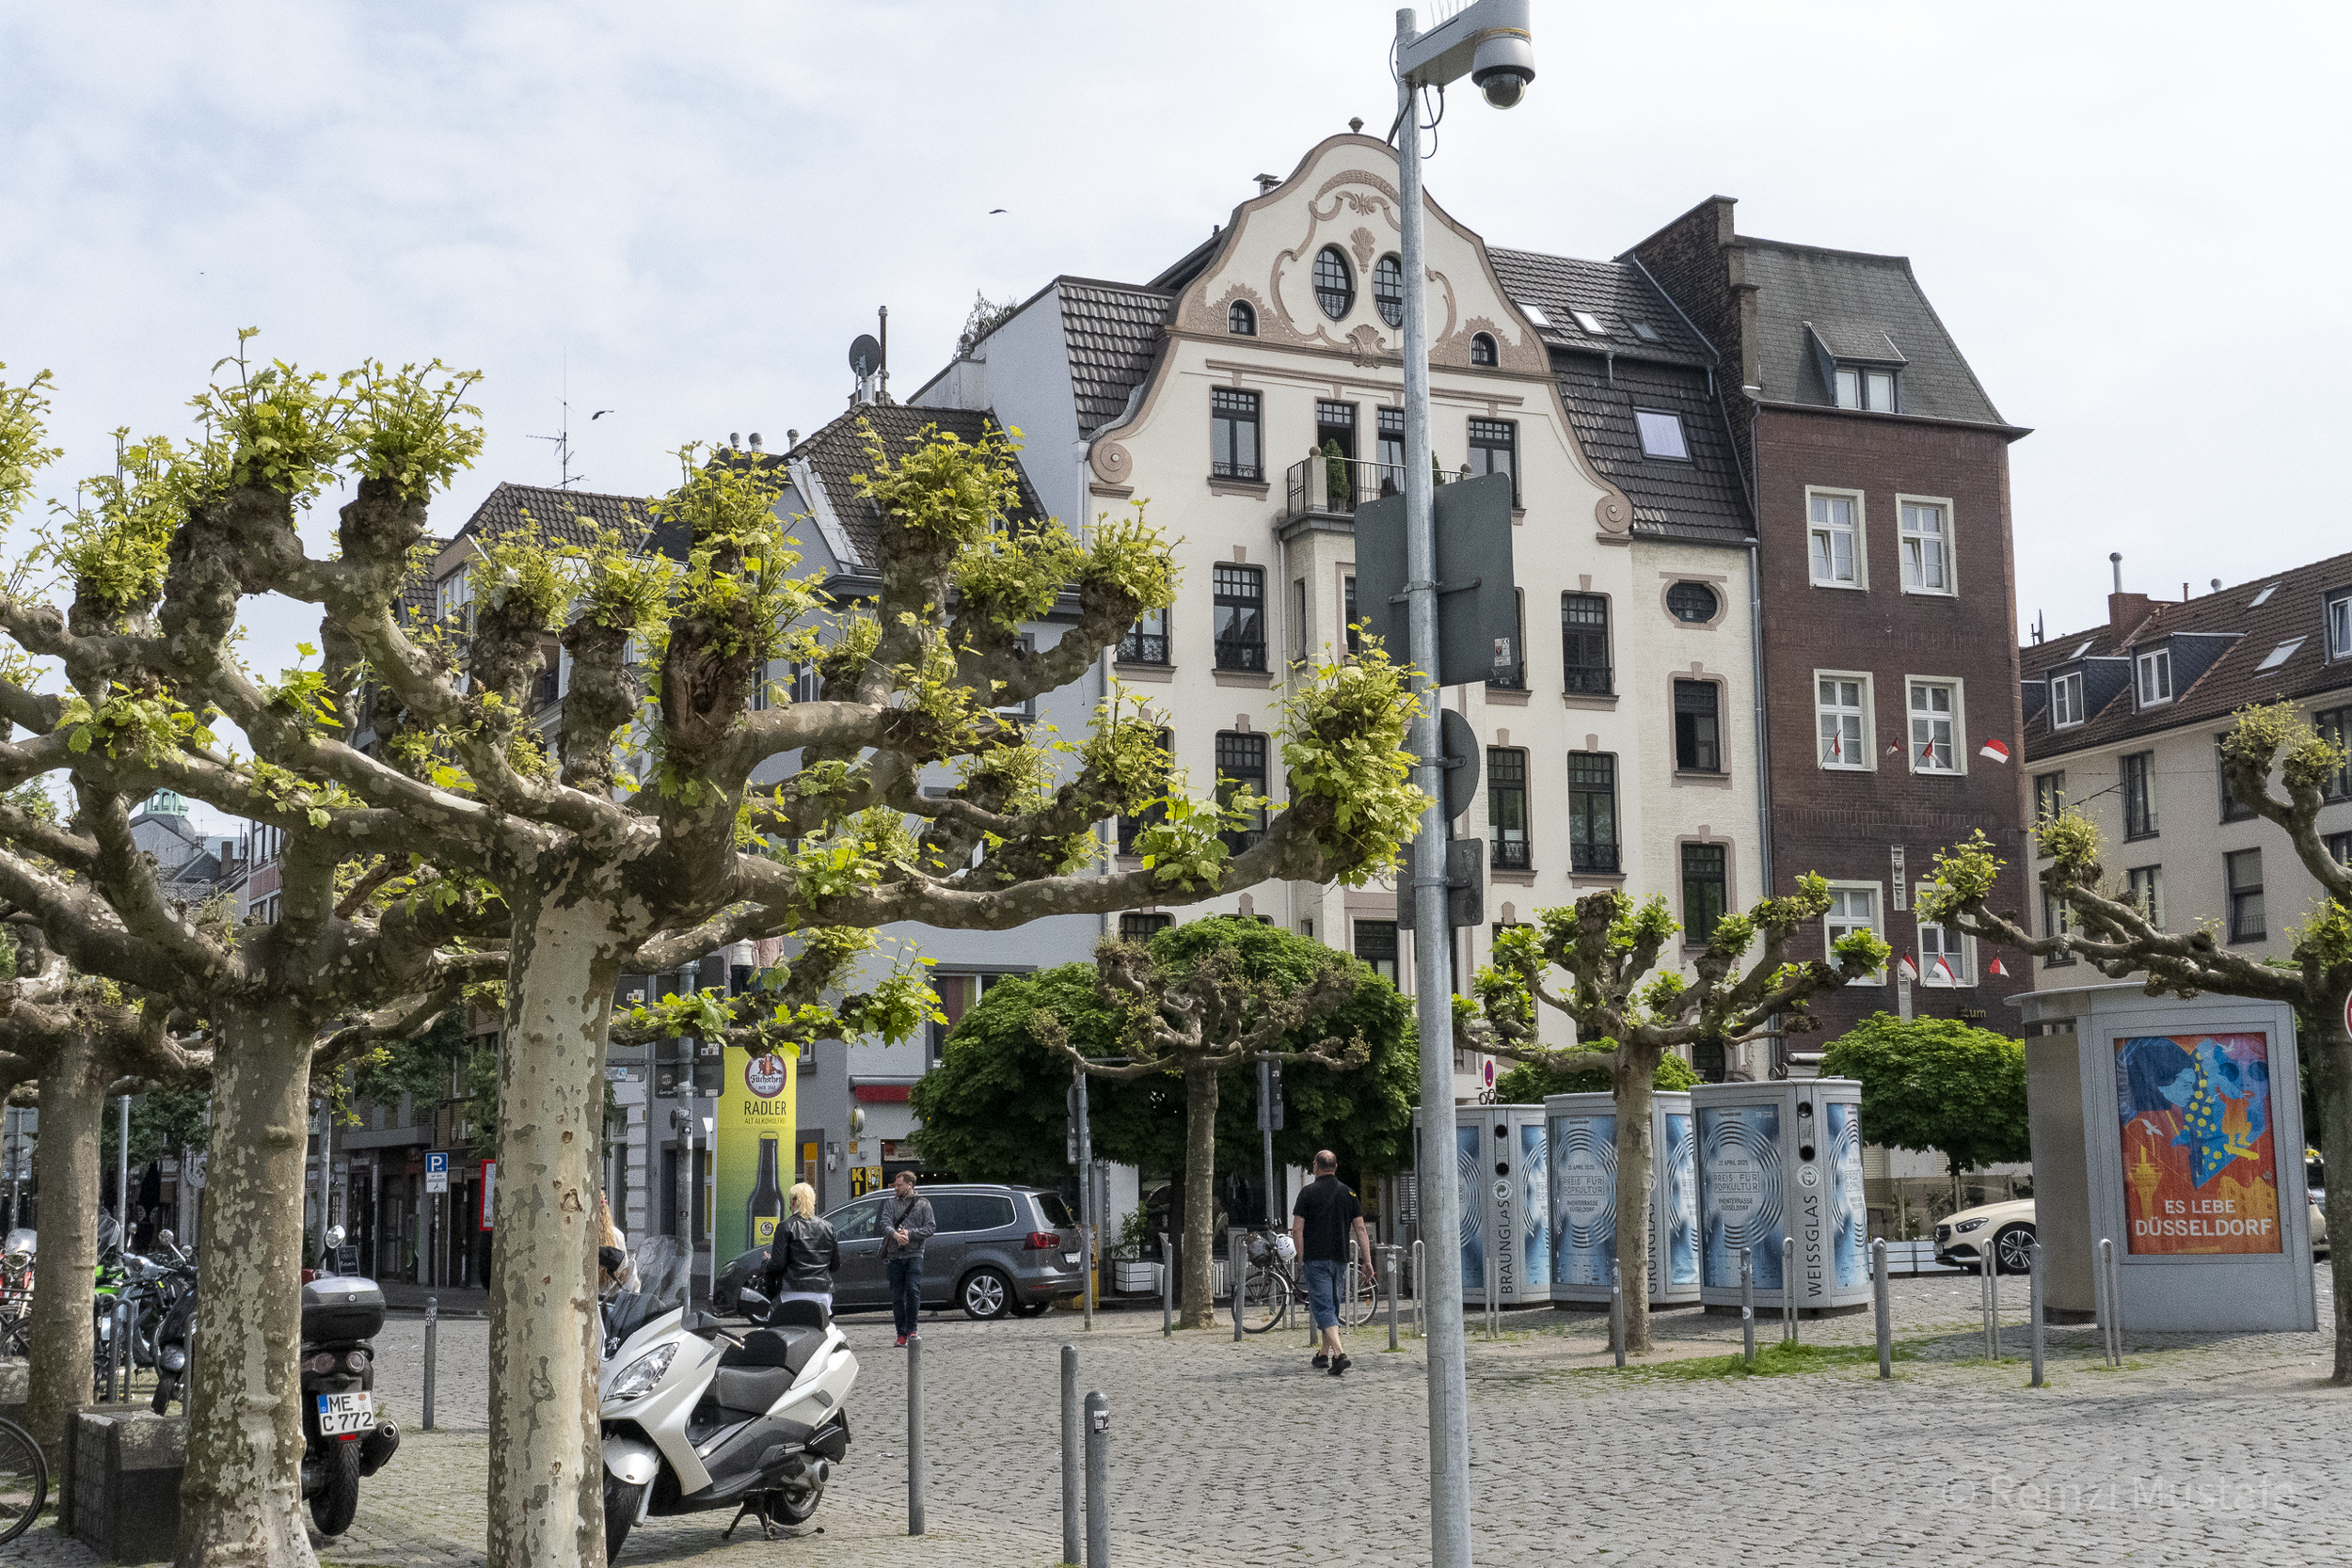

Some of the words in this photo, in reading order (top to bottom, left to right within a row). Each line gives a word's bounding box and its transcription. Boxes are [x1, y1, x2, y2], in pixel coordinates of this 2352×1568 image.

[744, 1101, 787, 1116] RADLER
[431, 1156, 443, 1172] P
[1714, 1174, 1733, 1182] PREIS
[1714, 1182, 1758, 1191] POPKULTUR
[2165, 1199, 2185, 1214] ES
[2191, 1199, 2236, 1213] LEBE
[2135, 1216, 2272, 1236] DÜSSELDORF
[1498, 1199, 1513, 1294] BRAUNGLAS
[1804, 1195, 1822, 1298] WEISSGLAS
[328, 1395, 354, 1414] ME
[322, 1416, 335, 1432] C
[338, 1411, 373, 1431] 772
